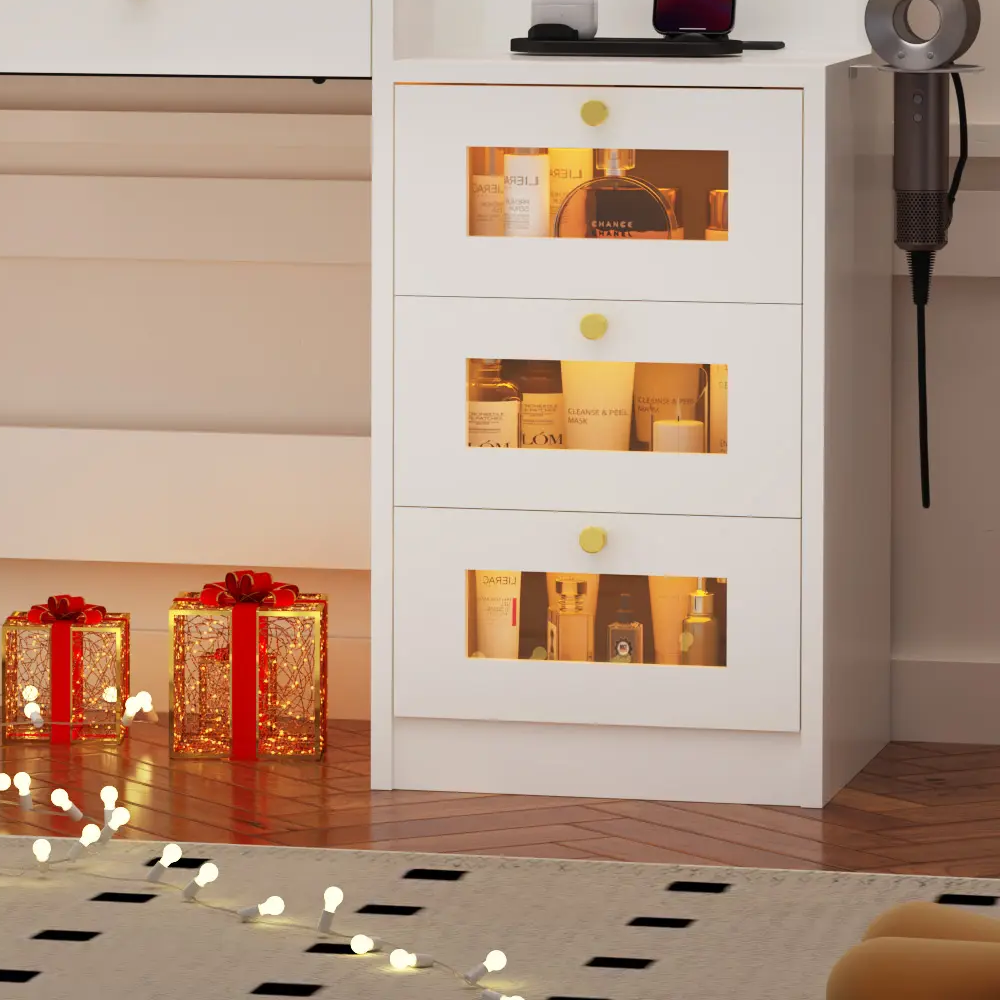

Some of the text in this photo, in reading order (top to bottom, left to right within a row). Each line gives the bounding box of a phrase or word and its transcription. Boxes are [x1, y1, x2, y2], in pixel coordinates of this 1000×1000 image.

[591, 220, 633, 228] CHANCE
[567, 407, 600, 416] CLEANSE
[609, 408, 629, 416] PEEL
[567, 417, 588, 425] MASK
